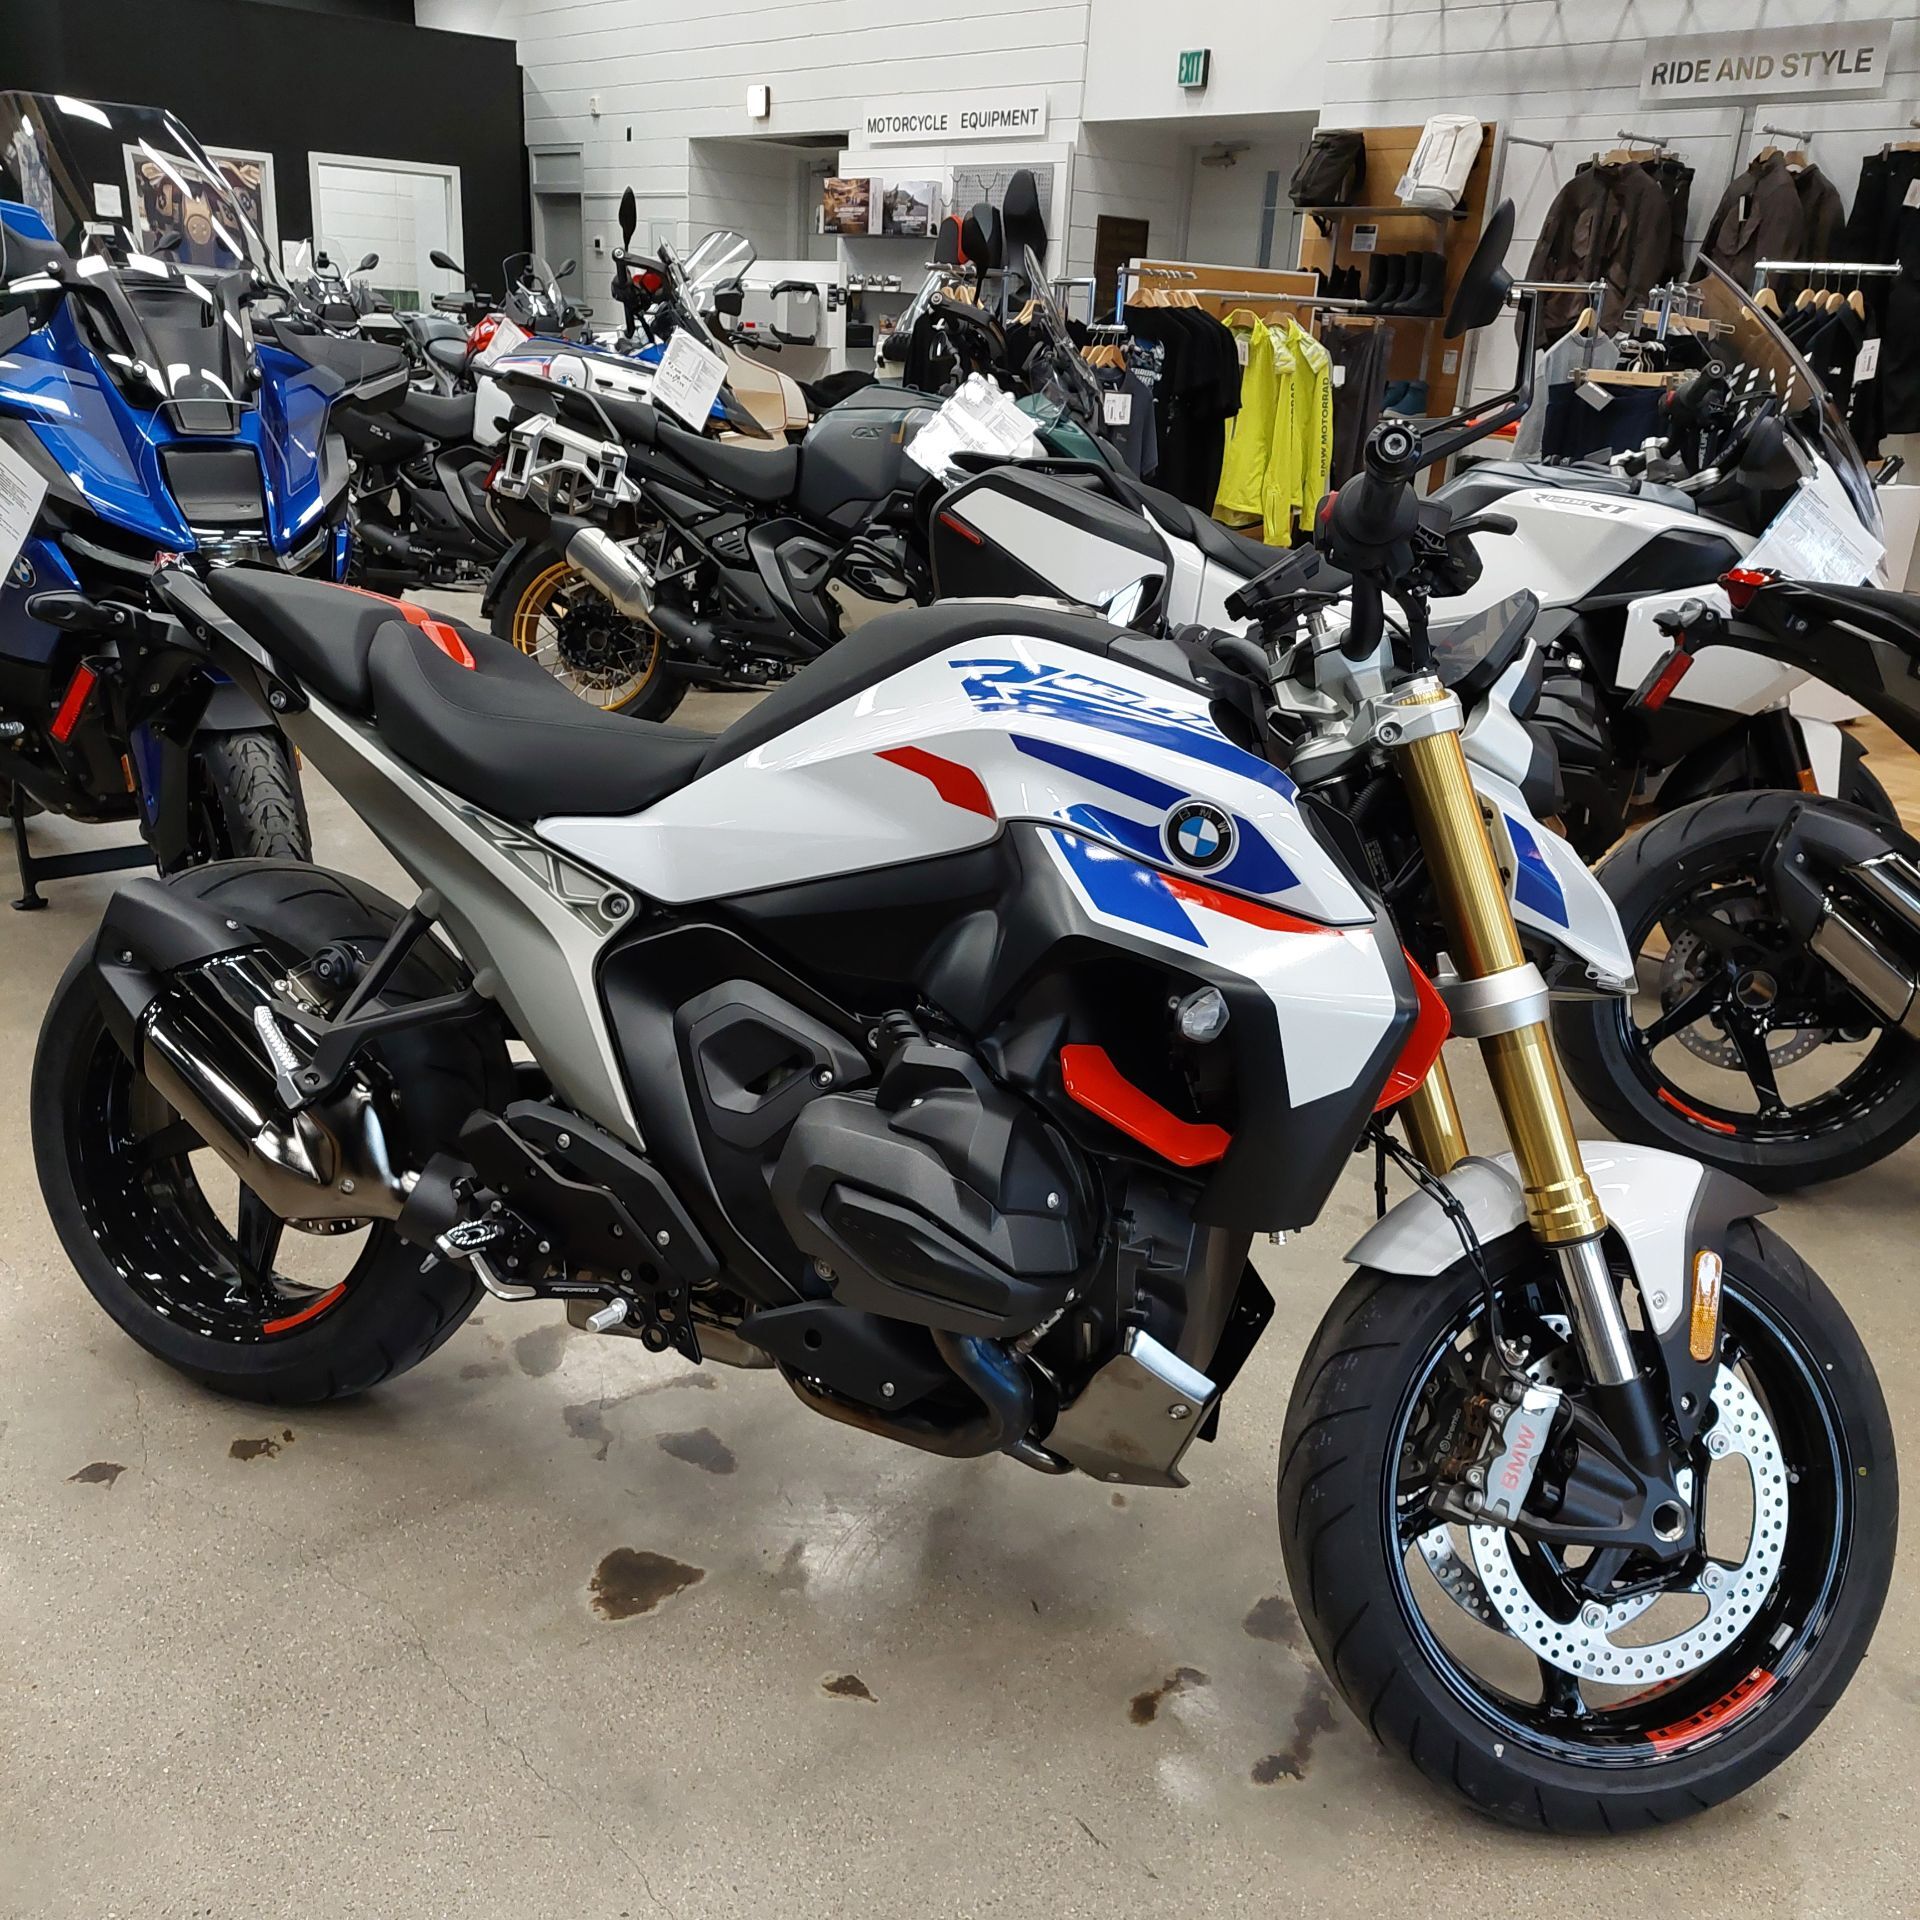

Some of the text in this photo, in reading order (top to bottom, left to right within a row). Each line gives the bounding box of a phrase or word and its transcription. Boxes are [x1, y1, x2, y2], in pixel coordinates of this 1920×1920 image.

[1178, 52, 1202, 83] EXIT
[1651, 47, 1875, 86] RIDE AND STYLE
[867, 108, 1039, 134] MOTORCYCLE EQUIPMENT
[1321, 377, 1329, 444] MOTORRAD
[1177, 807, 1231, 835] BMW
[1443, 1407, 1462, 1440] brembo
[1500, 1423, 1536, 1491] BMW
